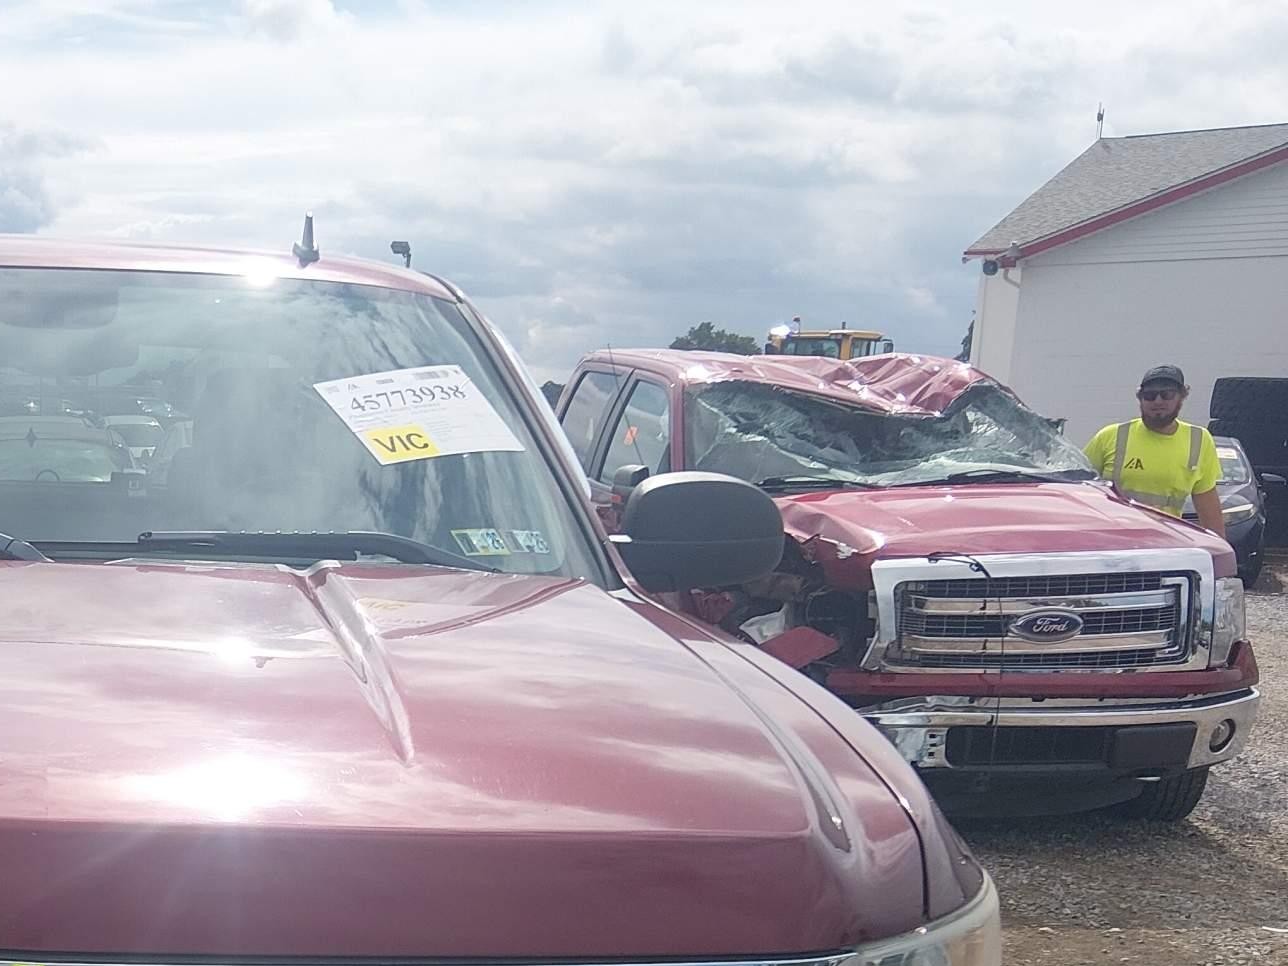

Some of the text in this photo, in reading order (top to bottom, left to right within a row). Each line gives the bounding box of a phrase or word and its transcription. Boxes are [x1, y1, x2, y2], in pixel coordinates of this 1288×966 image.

[350, 384, 467, 412] 45773938
[373, 432, 430, 454] VIC
[1032, 617, 1070, 633] Ford
